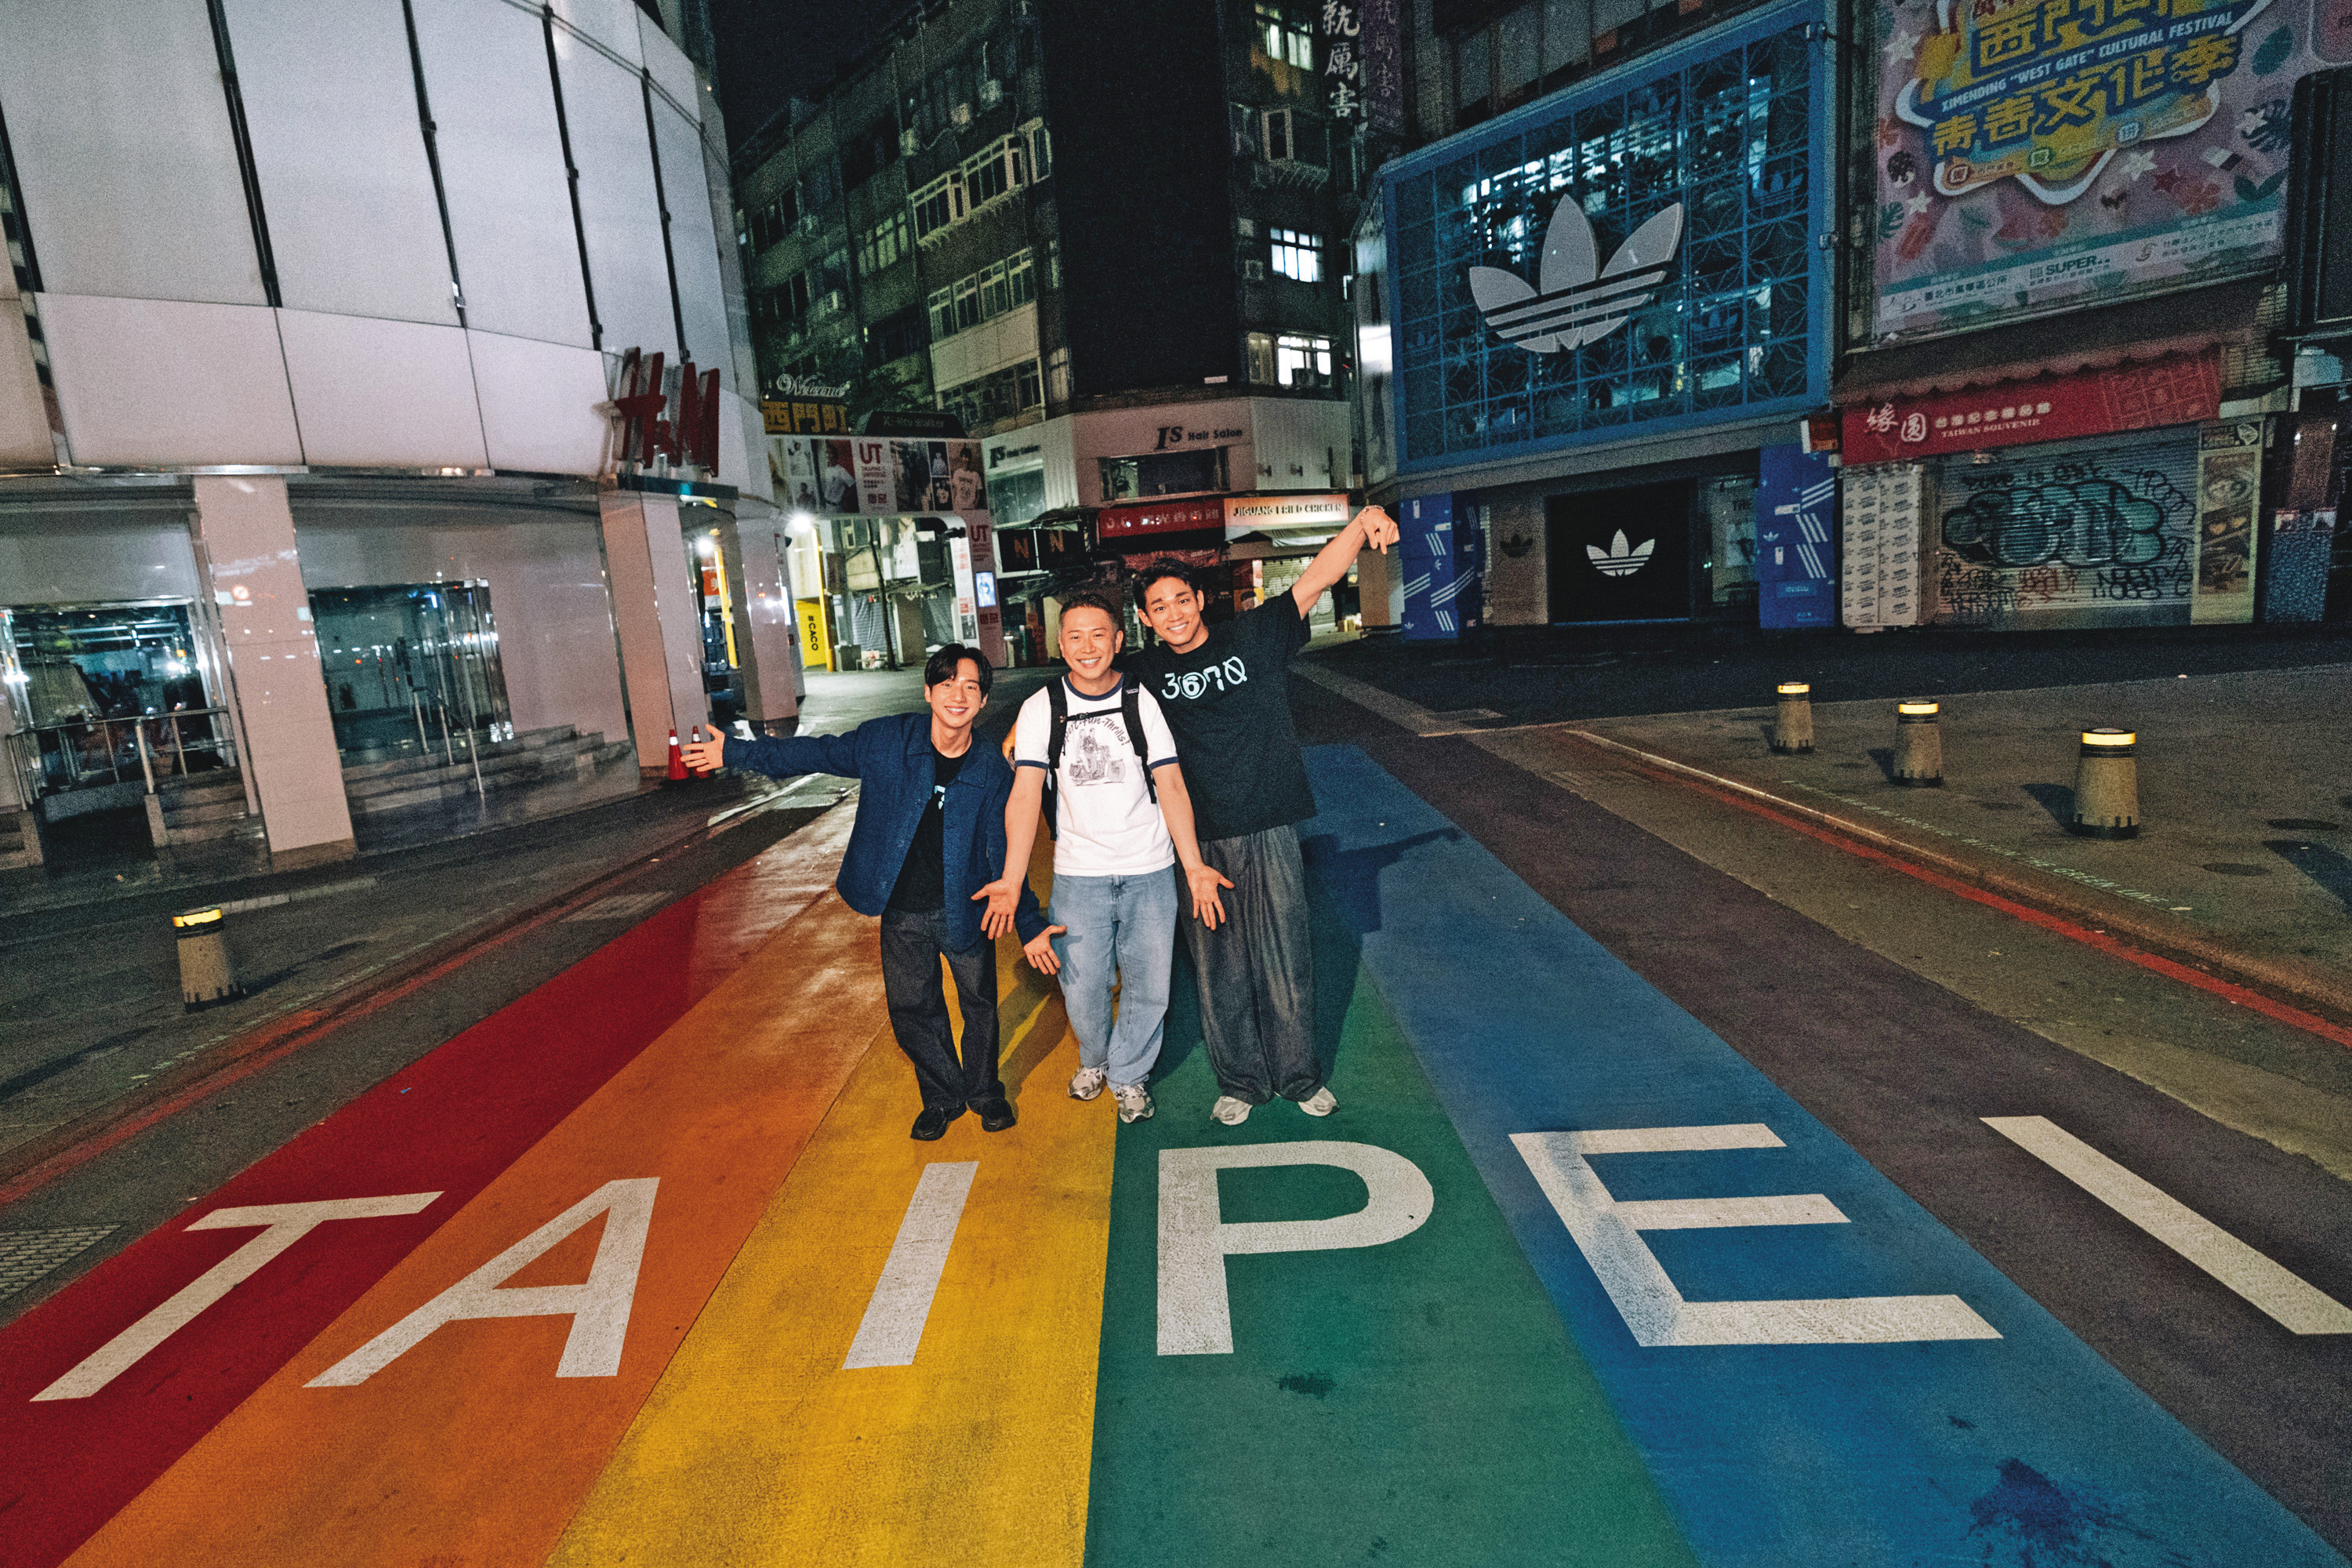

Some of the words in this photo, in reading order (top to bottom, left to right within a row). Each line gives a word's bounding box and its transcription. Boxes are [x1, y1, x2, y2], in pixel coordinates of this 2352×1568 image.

[1941, 78, 2007, 113] XIMENDING
[2098, 30, 2165, 59] CULTURAL
[2168, 11, 2234, 39] FESTIVAL
[1933, 34, 2238, 156] 青春文化季
[761, 400, 847, 435] 西門町
[1188, 430, 1210, 441] Hair
[1213, 428, 1243, 440] Salon
[1941, 426, 1981, 438] TAIWAN
[859, 442, 883, 464] UT
[1233, 505, 1274, 517] JIGUANG
[1304, 503, 1344, 514] CHICKEN
[970, 524, 989, 542] UT
[807, 615, 819, 652] #CACO
